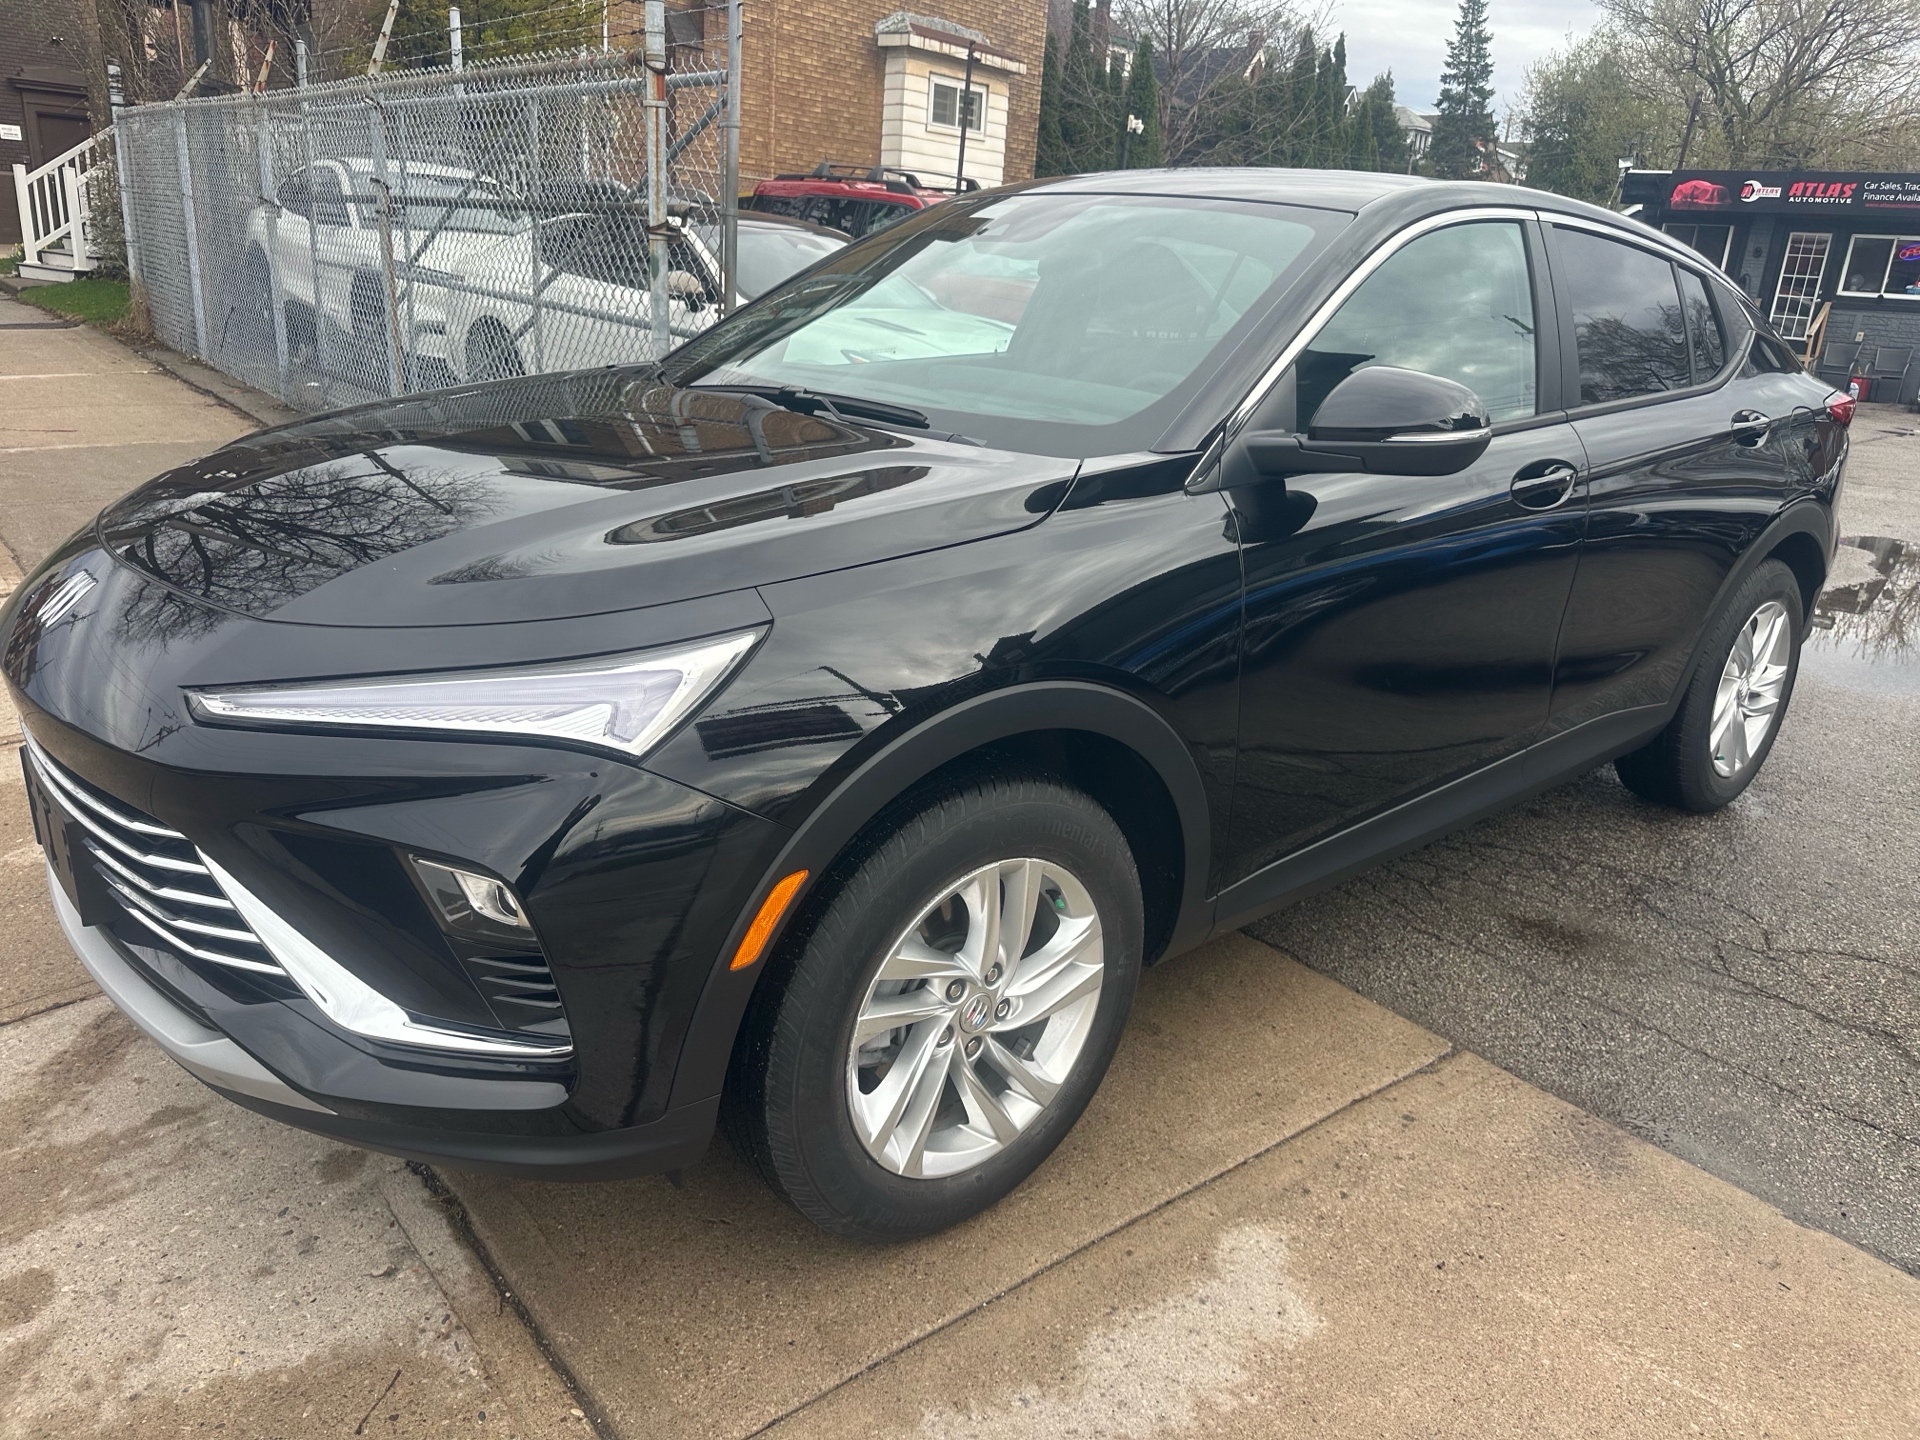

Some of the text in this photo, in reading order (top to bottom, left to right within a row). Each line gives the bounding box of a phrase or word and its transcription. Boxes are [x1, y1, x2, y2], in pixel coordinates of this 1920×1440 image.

[1788, 182, 1857, 197] ATLAS
[1864, 181, 1879, 190] Car
[1880, 182, 1902, 191] Sales,
[1862, 192, 1895, 201] Finance
